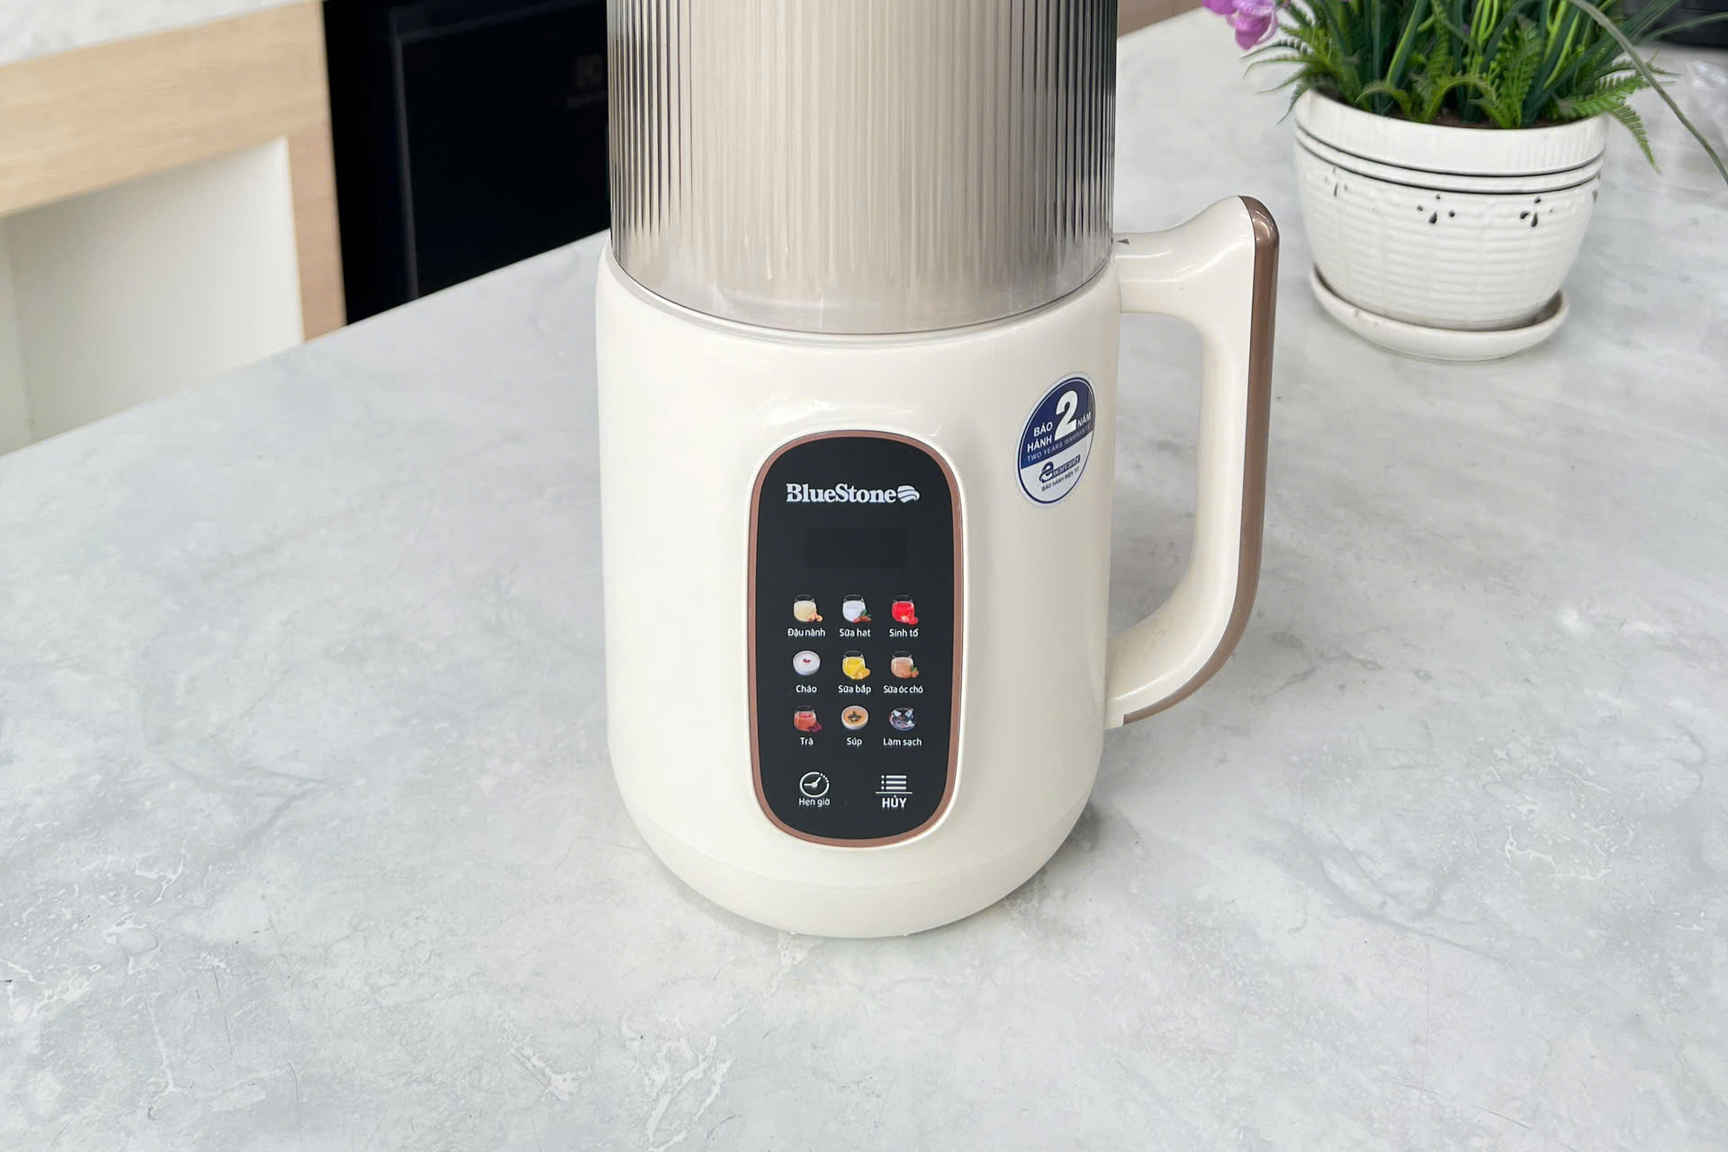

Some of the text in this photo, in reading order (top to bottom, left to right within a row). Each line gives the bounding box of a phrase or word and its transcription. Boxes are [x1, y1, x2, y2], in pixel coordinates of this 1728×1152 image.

[1055, 390, 1078, 441] 2
[786, 483, 897, 503] BlueStone
[889, 628, 908, 637] Sinh
